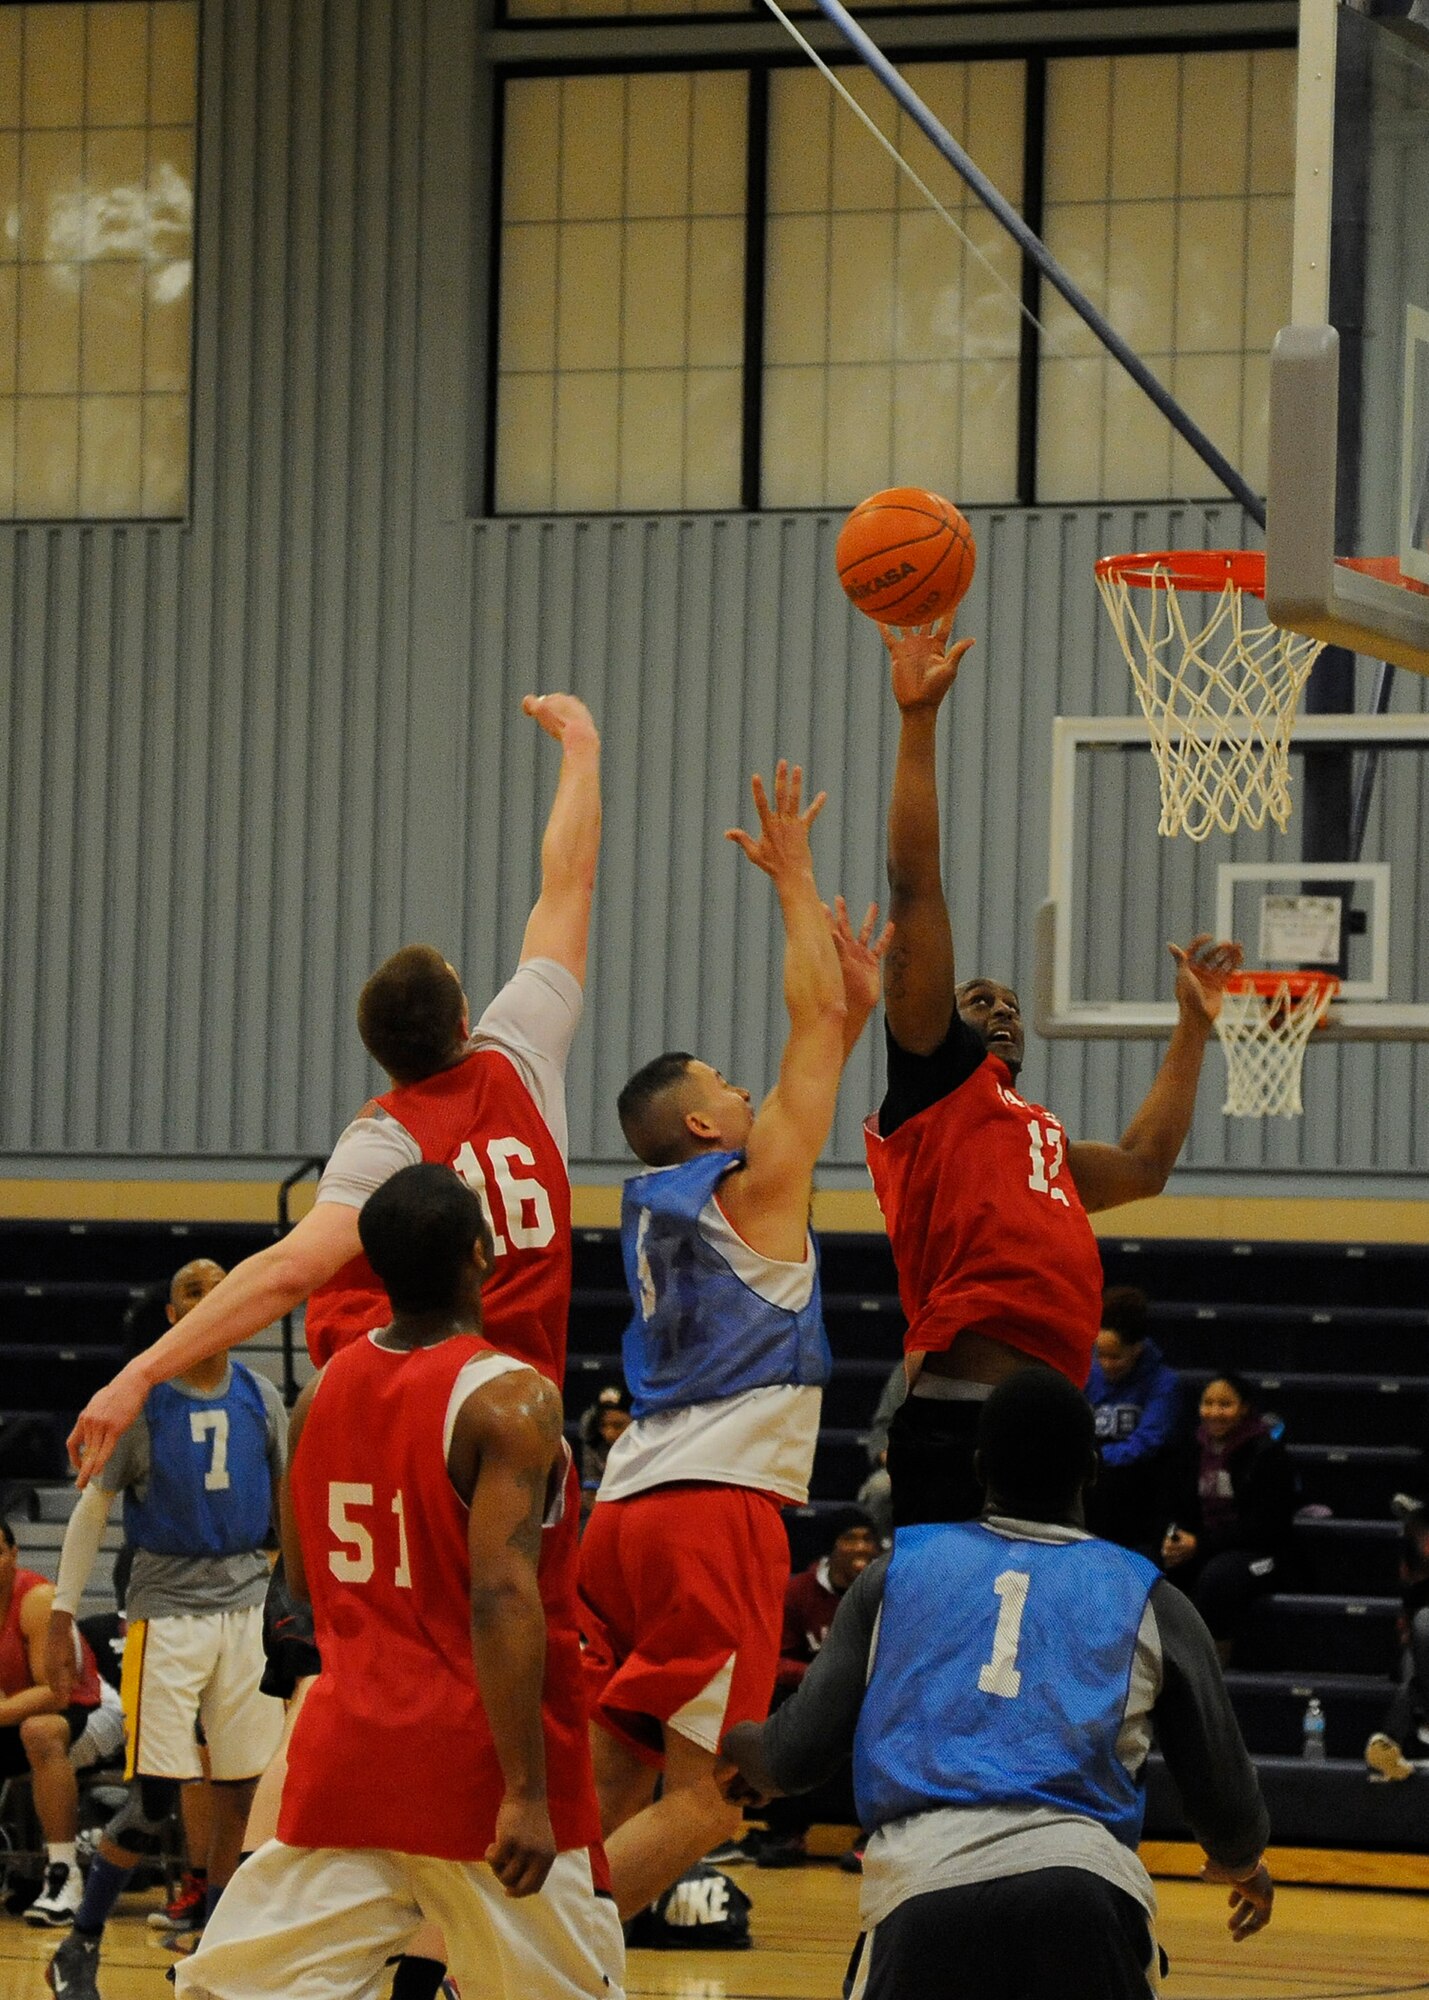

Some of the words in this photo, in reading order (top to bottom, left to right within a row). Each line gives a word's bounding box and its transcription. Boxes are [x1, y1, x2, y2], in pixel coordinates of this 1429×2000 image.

[452, 1136, 556, 1256] 16
[190, 1409, 230, 1490] 7
[328, 1481, 412, 1589] 51
[977, 1568, 1031, 1699] 1
